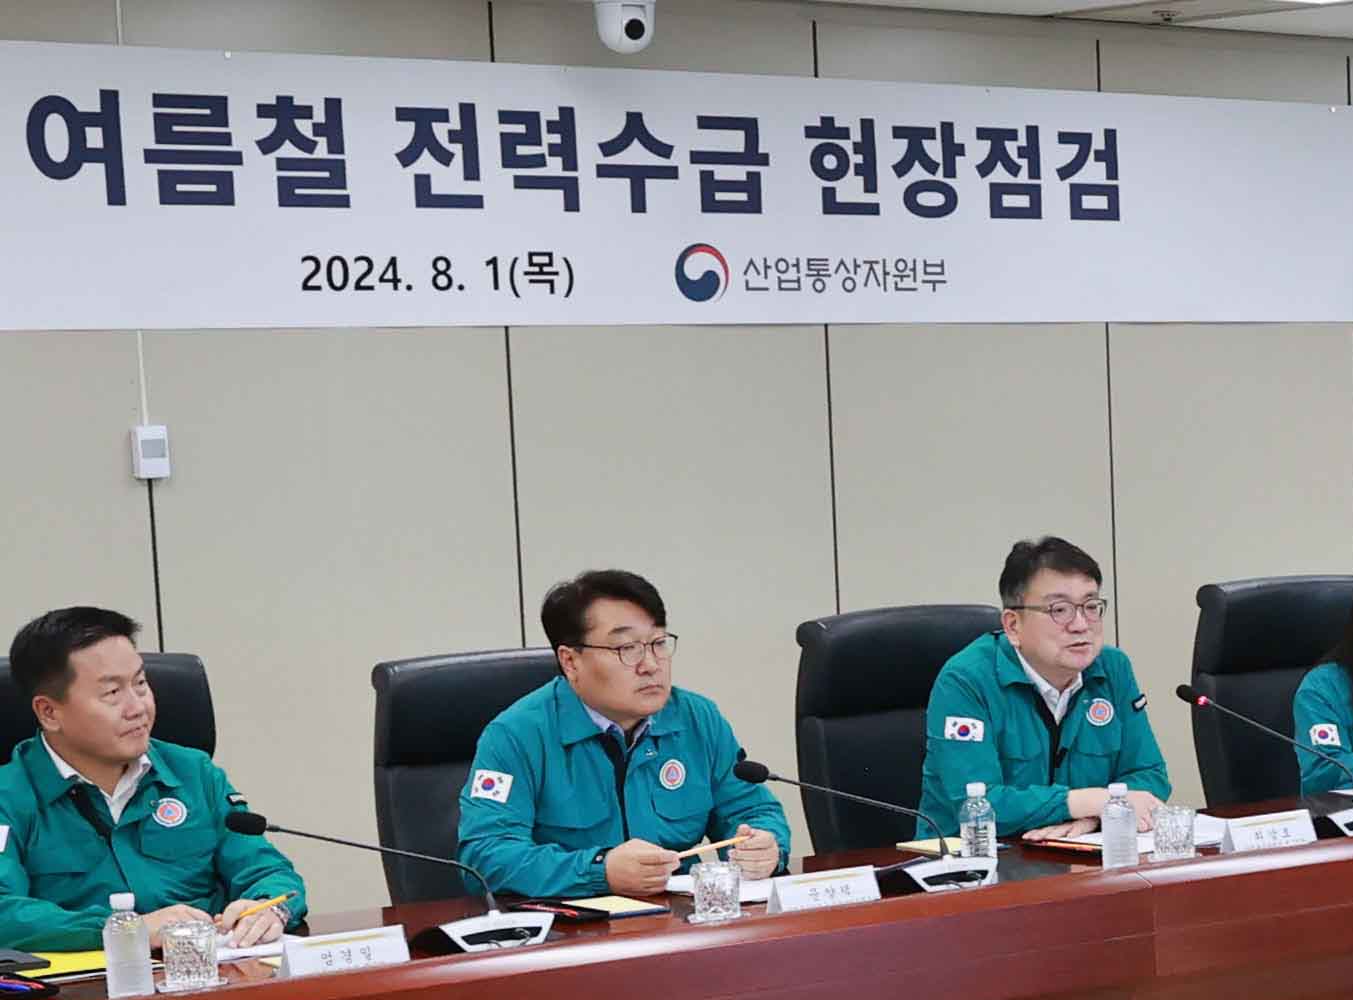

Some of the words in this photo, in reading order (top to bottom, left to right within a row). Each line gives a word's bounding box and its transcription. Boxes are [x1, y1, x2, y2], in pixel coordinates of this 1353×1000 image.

[26, 88, 351, 209] 여름철
[394, 102, 770, 215] 전력수급
[804, 116, 1121, 222] 현장점검
[301, 255, 413, 292] 2024.
[431, 255, 466, 292] 8.
[485, 251, 574, 298] 1(목)
[743, 257, 948, 294] 산업통상자원부
